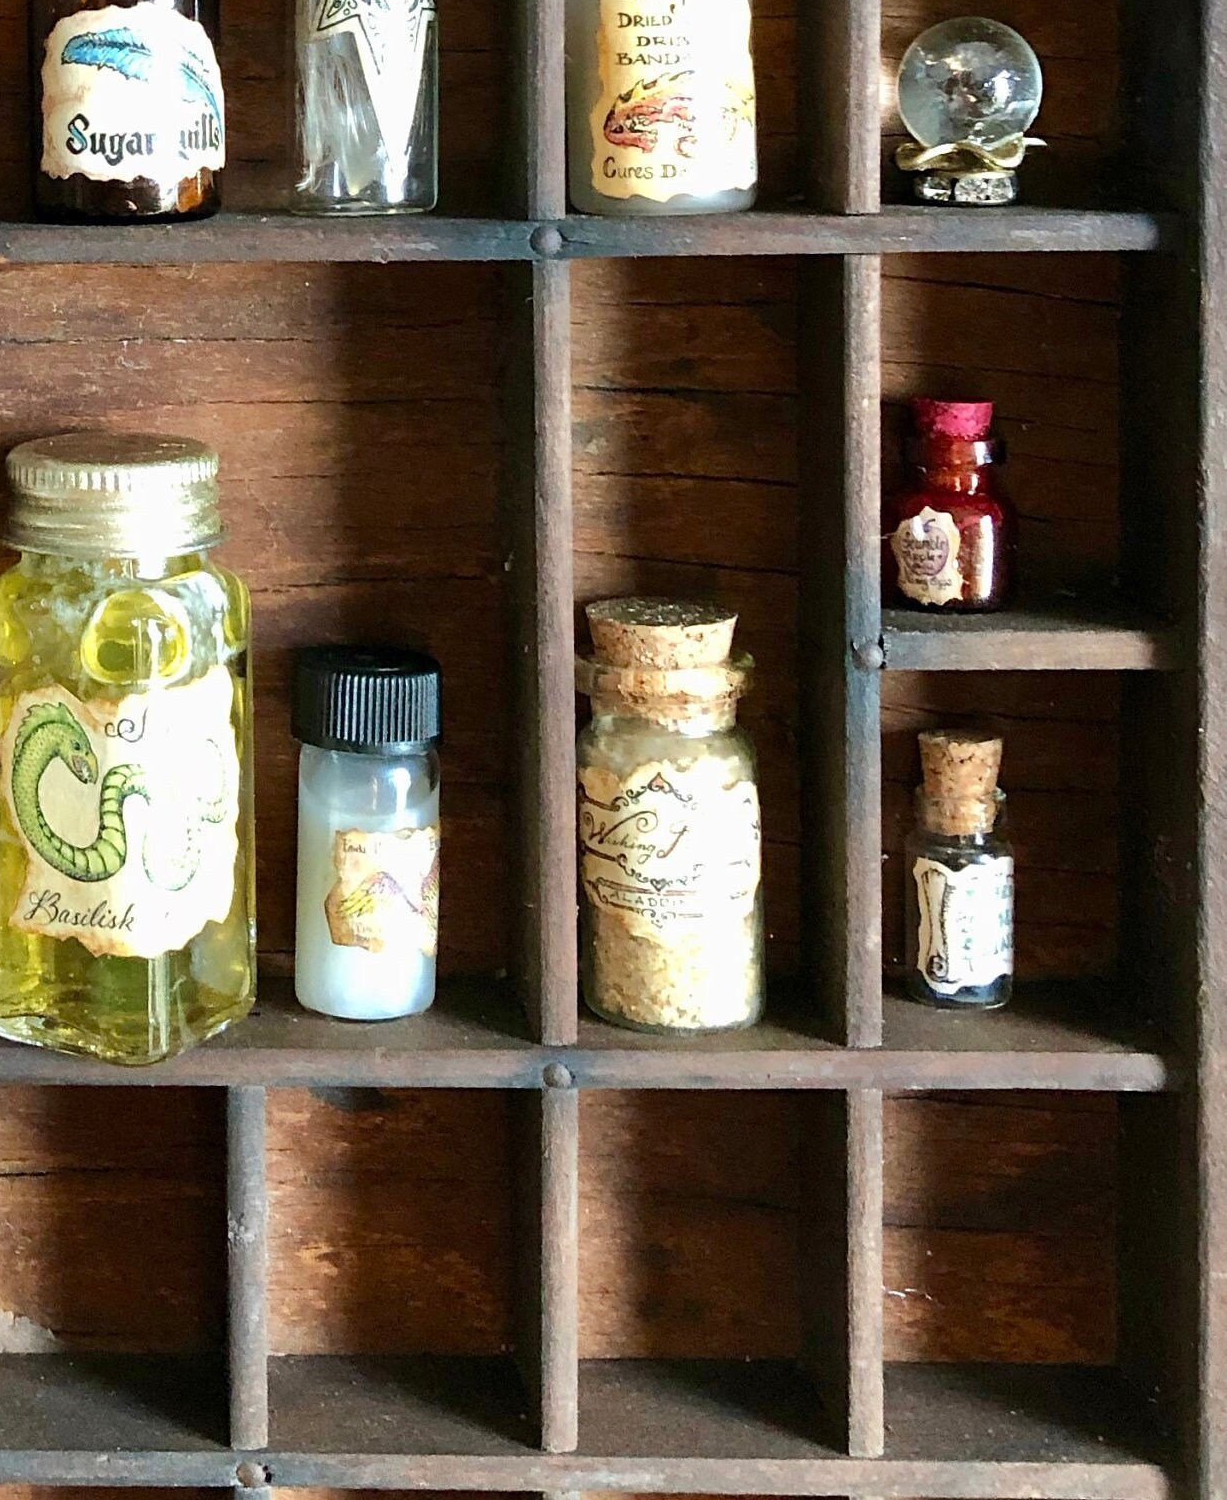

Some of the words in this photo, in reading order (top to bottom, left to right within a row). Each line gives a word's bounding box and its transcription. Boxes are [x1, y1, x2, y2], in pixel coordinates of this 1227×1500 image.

[616, 11, 674, 29] DRIED
[614, 51, 682, 66] BAND
[64, 112, 158, 167] Sugar
[177, 111, 221, 162] uills
[602, 155, 654, 180] Cures
[22, 889, 136, 932] Basilisk
